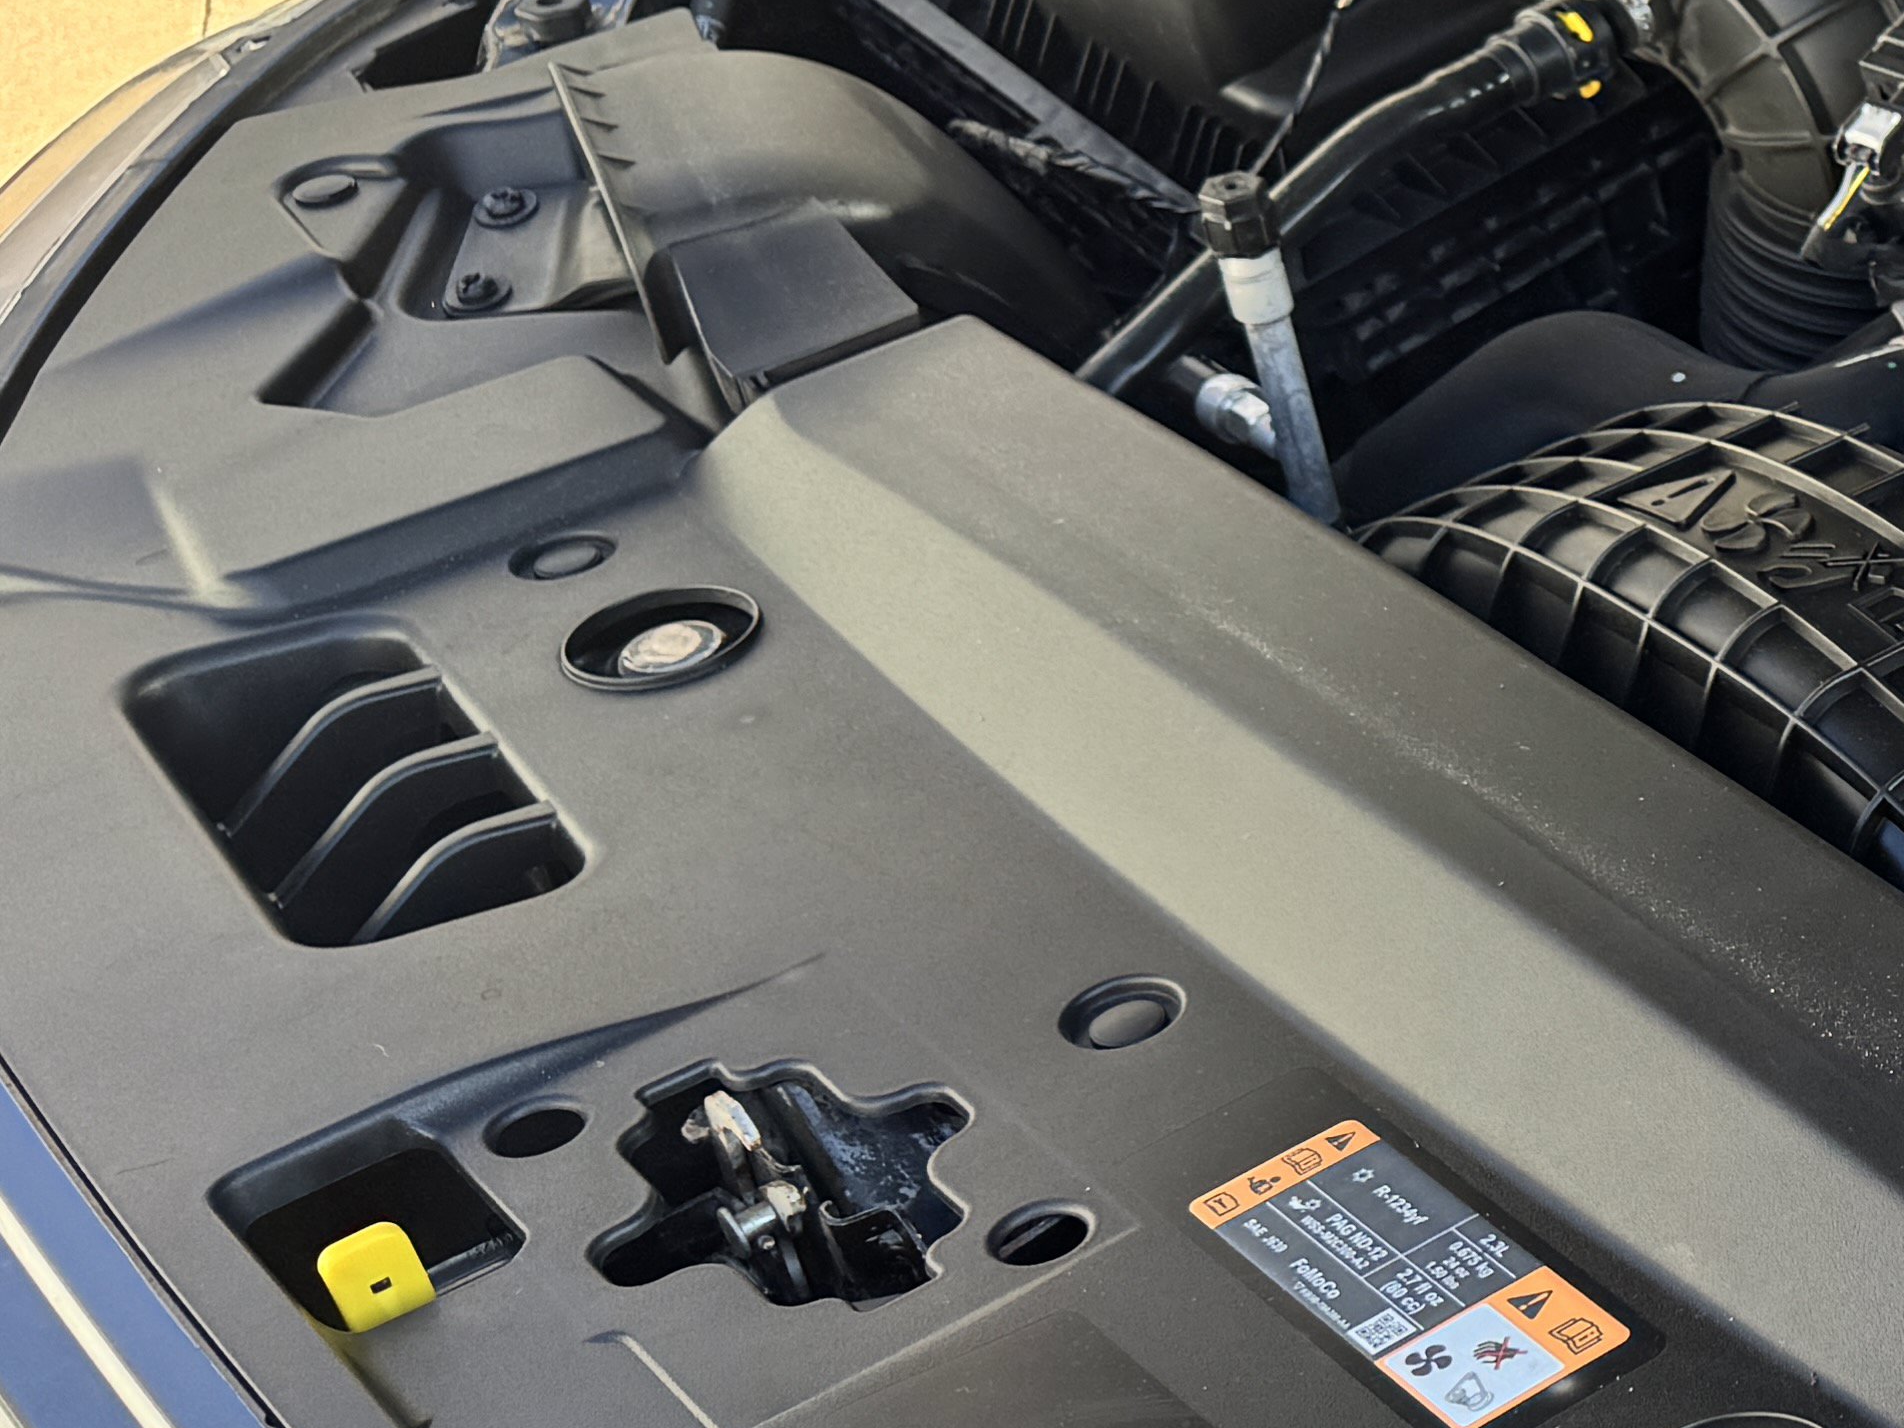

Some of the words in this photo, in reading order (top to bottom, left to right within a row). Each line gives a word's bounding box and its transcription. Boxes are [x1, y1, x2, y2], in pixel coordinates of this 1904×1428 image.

[1371, 1183, 1430, 1227] R-1234yf
[1325, 1212, 1357, 1238] PAG
[1351, 1231, 1389, 1263] ND-12
[1478, 1233, 1510, 1258] 2.3L
[1290, 1257, 1341, 1300] FoMoCo
[1448, 1240, 1483, 1267] 0.675
[1475, 1261, 1495, 1280] kg
[1396, 1268, 1423, 1286] 2.7
[1424, 1292, 1445, 1307] oz
